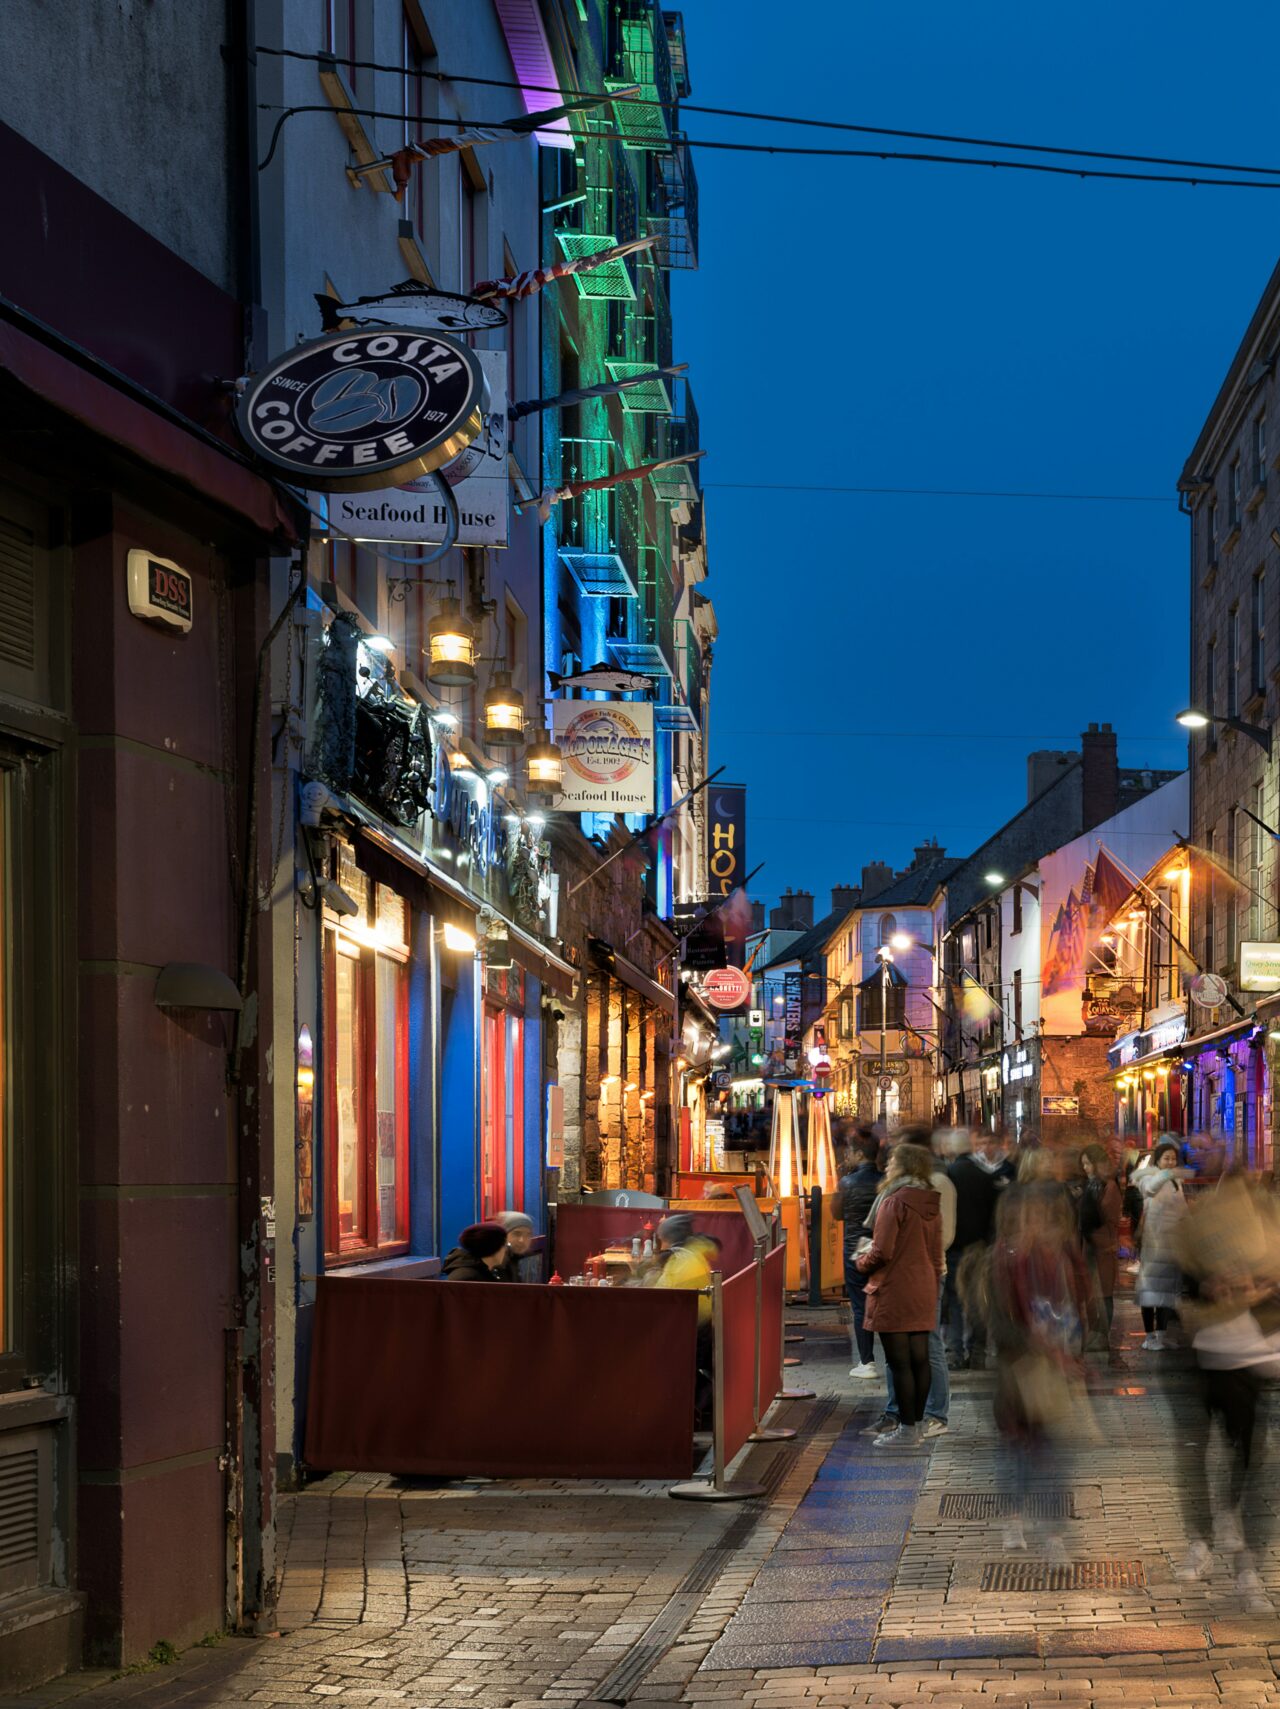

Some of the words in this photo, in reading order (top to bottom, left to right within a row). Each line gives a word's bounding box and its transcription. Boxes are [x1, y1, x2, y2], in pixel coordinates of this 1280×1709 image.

[332, 336, 462, 384] COSTA
[272, 375, 308, 393] SINCE
[423, 409, 447, 424] 1971
[255, 401, 415, 466] COFFEE
[341, 501, 425, 524] Seafood
[433, 504, 497, 529] Huse
[155, 568, 187, 606] DSS
[561, 789, 607, 801] Seafood
[611, 790, 647, 802] House
